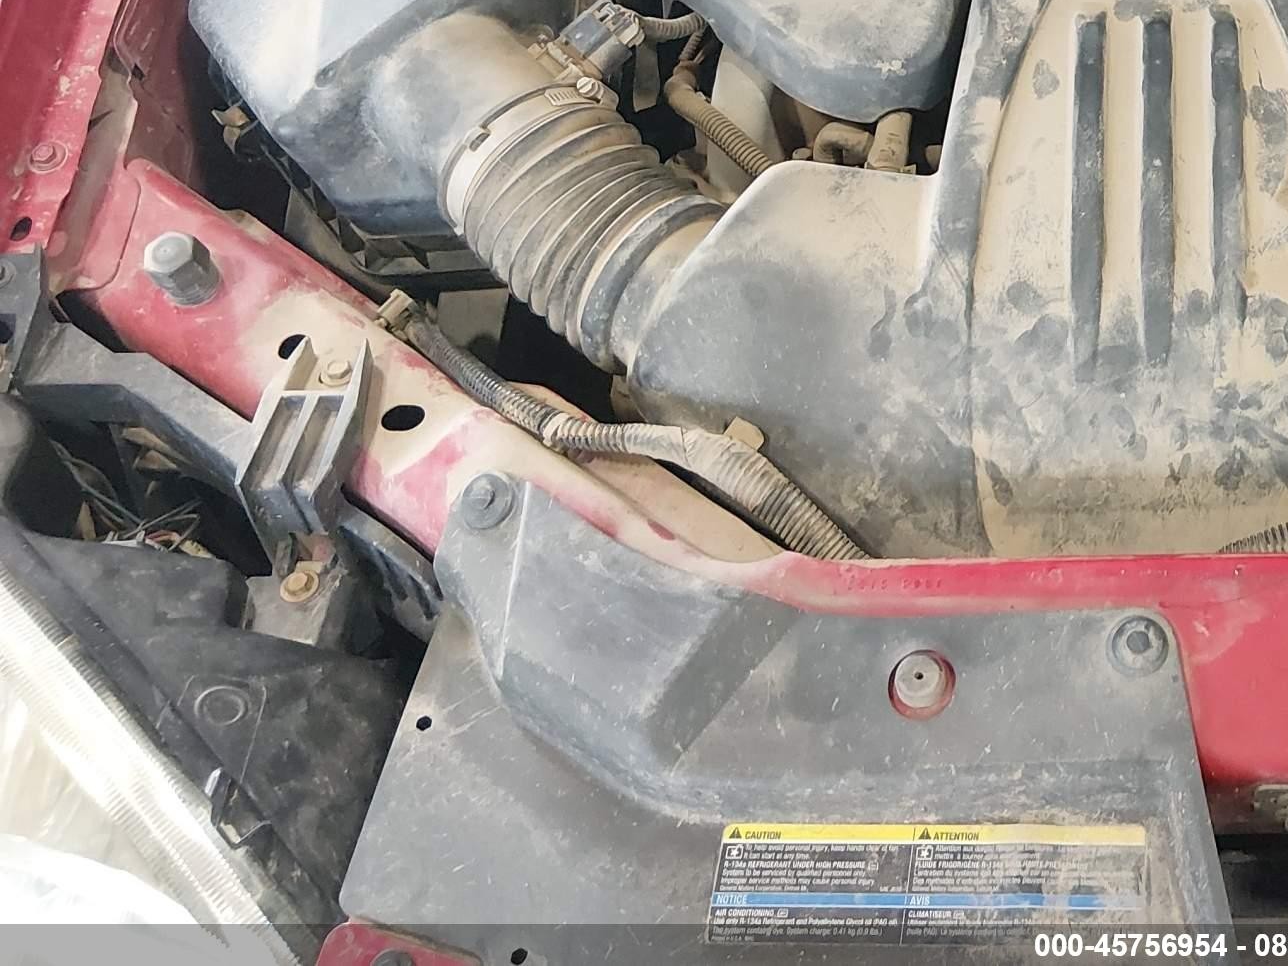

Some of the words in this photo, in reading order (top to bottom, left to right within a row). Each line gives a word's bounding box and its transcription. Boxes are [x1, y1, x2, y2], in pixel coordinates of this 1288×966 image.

[745, 831, 782, 839] CAUTION
[933, 832, 979, 841] ATTENTION
[716, 895, 747, 904] NOTICE
[910, 895, 930, 905] AVIS
[715, 909, 726, 917] AIR
[728, 909, 774, 917] CONDITIONING
[908, 910, 951, 918] CLIMATISEUR
